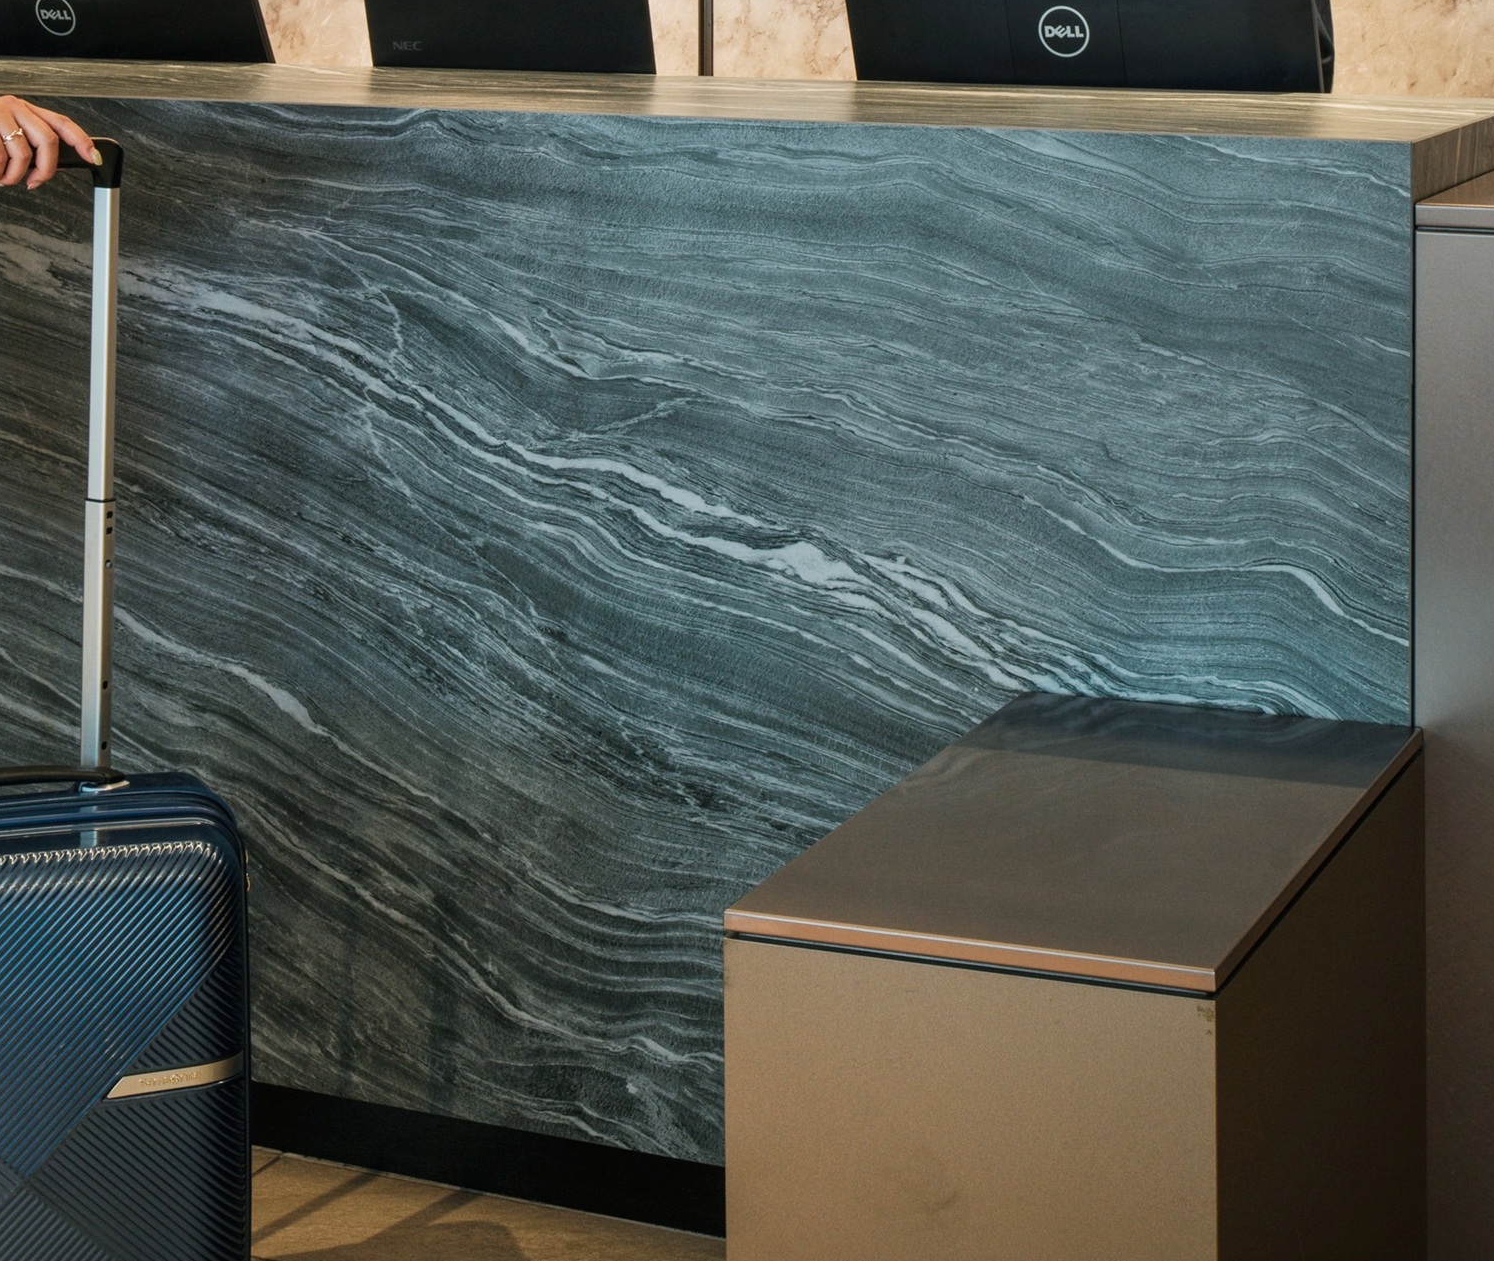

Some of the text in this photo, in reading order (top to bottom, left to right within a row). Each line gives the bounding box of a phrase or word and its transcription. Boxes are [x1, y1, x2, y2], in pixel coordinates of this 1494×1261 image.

[39, 9, 72, 20] DELL
[1044, 24, 1085, 39] DELL
[392, 40, 423, 51] NEC
